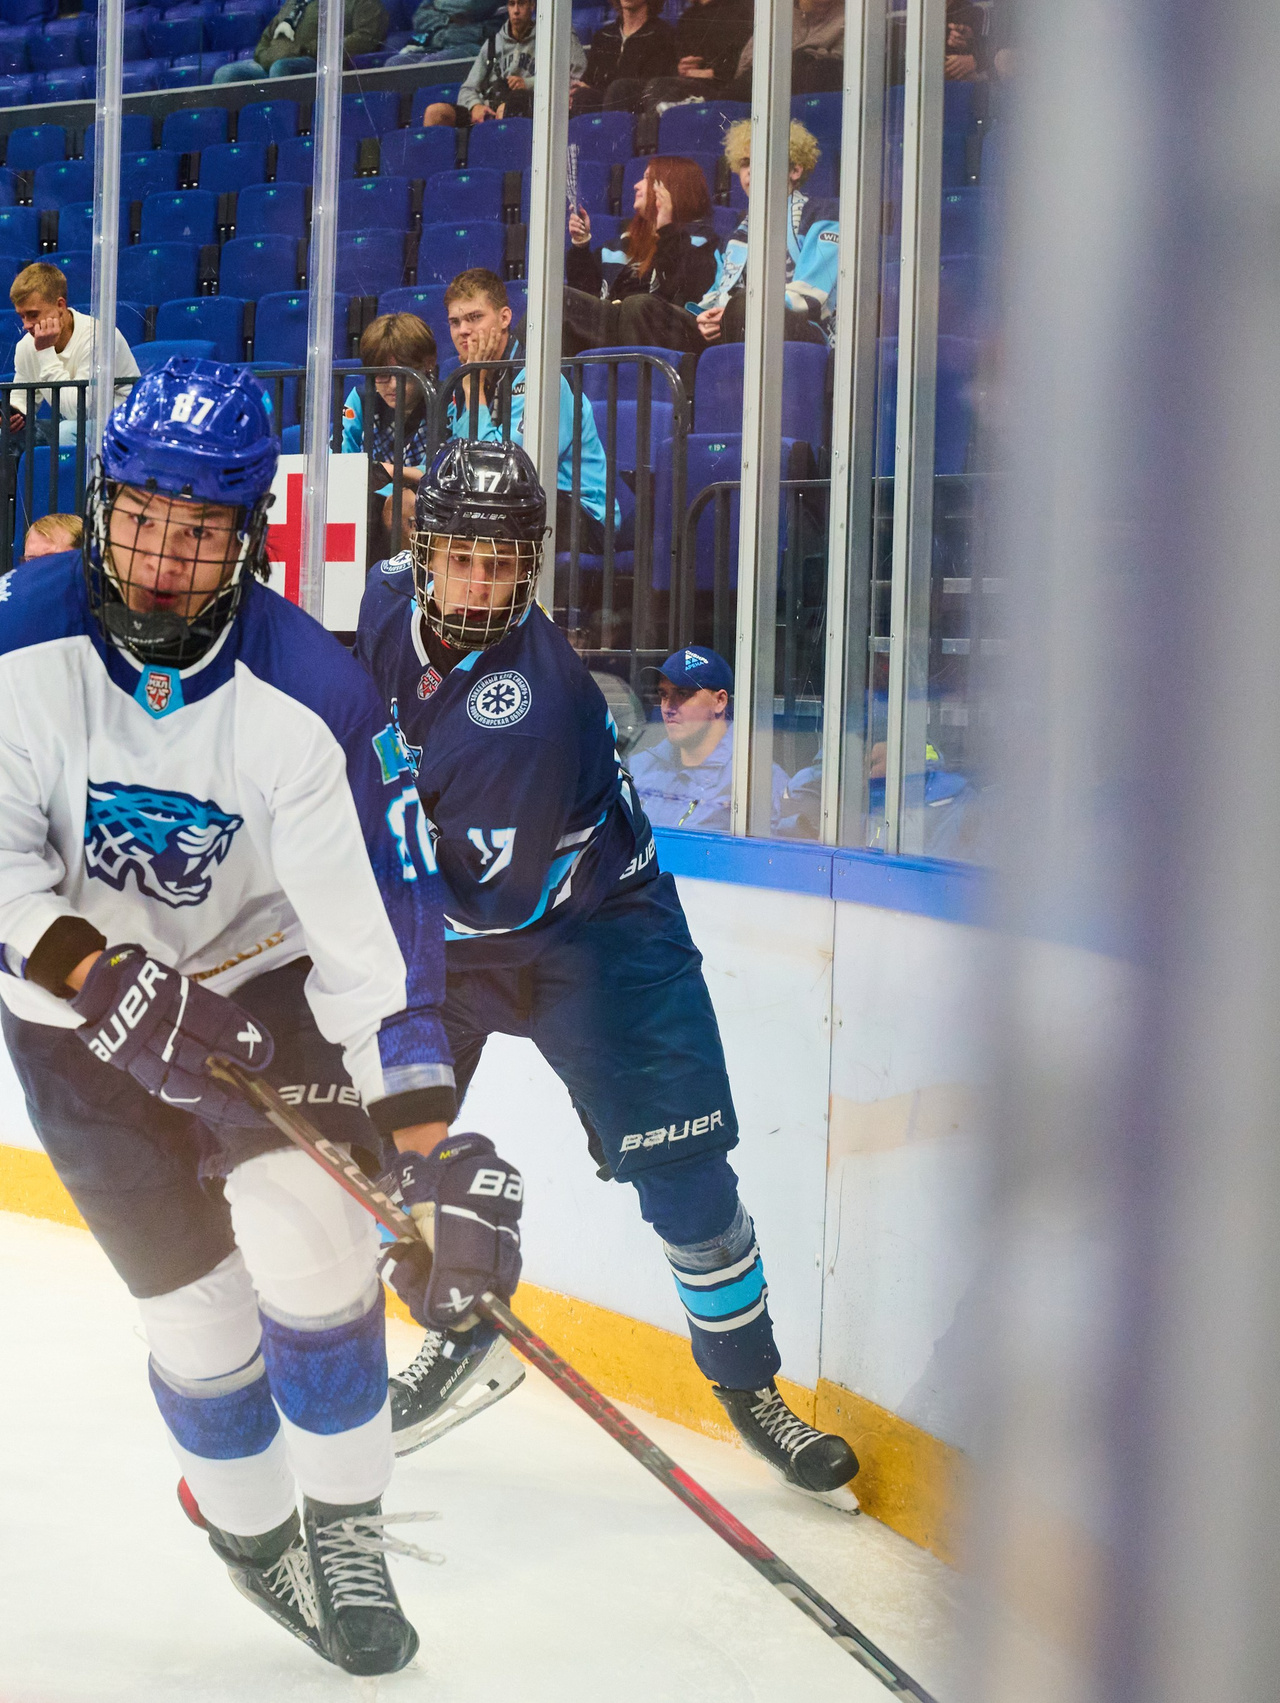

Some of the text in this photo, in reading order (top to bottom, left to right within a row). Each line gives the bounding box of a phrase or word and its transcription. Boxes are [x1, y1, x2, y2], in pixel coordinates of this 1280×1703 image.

[171, 393, 215, 425] 87
[478, 471, 501, 492] 17
[88, 959, 169, 1062] AUER
[619, 1109, 725, 1153] BAUER
[440, 1357, 470, 1398] BAUER
